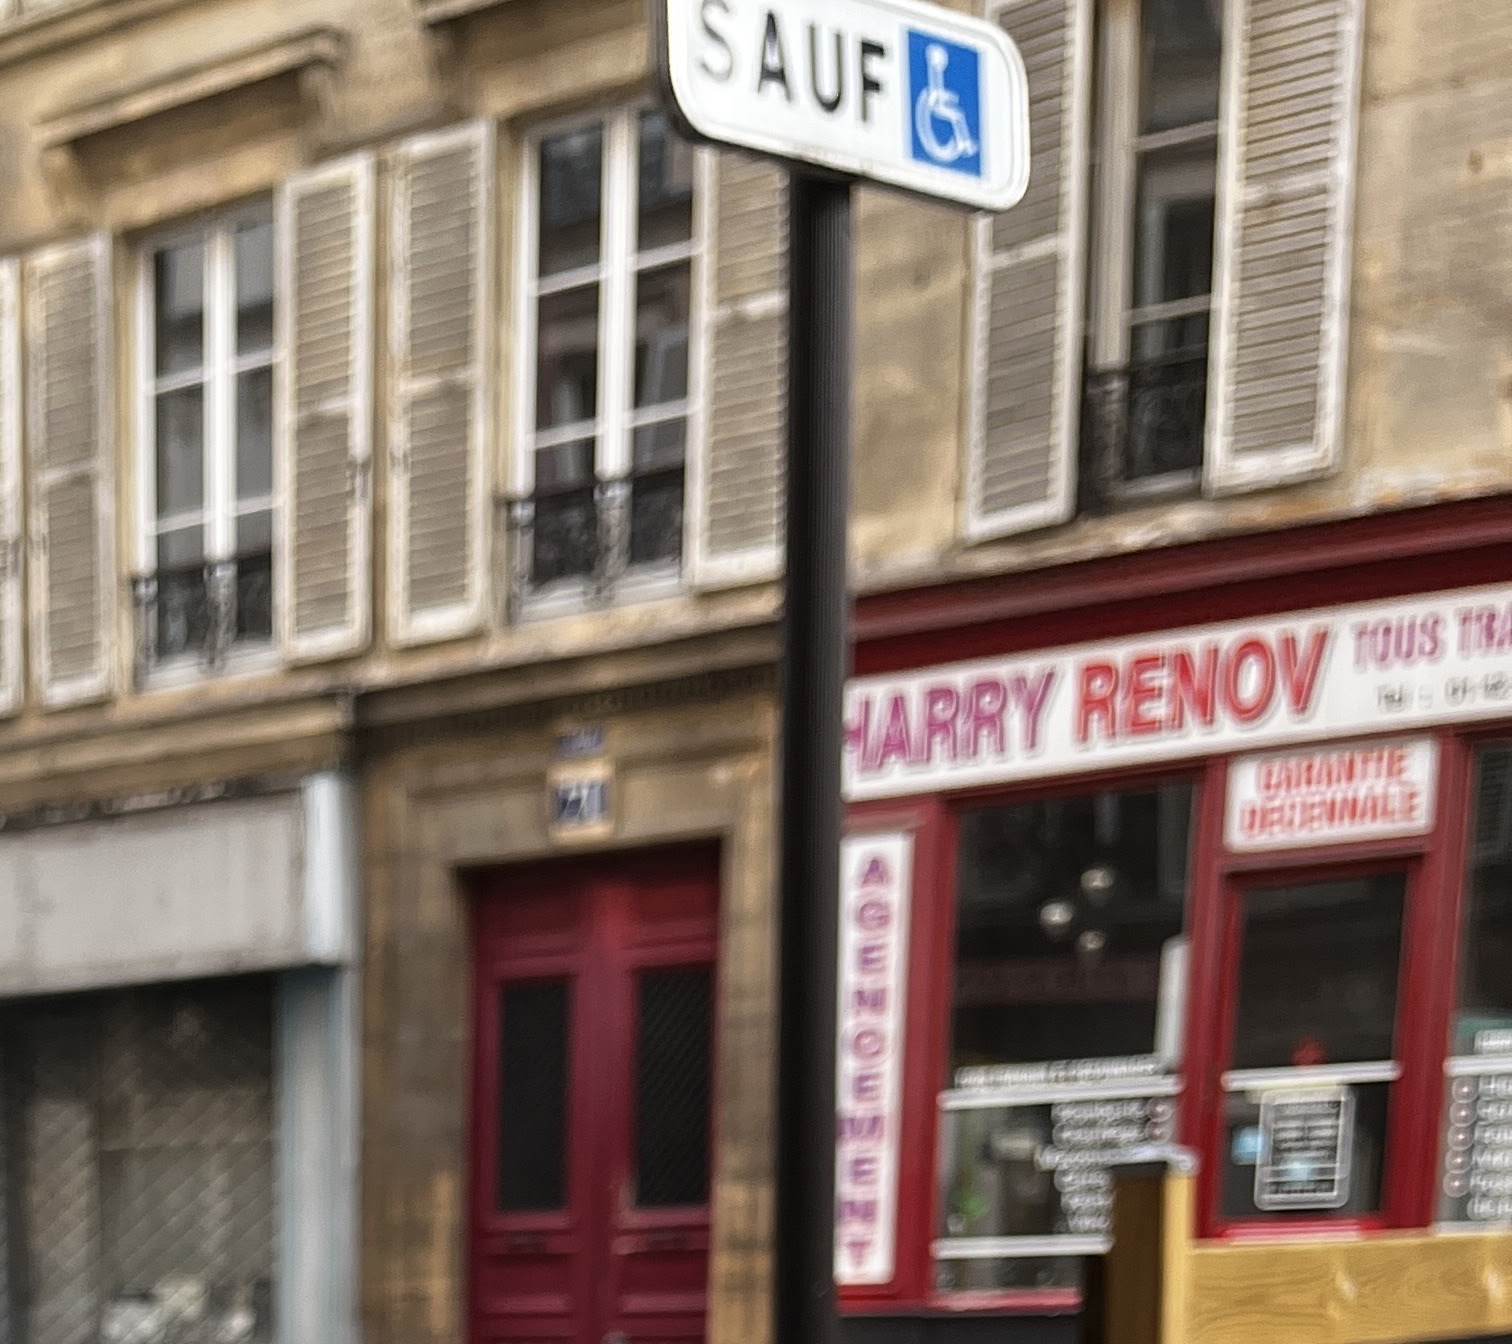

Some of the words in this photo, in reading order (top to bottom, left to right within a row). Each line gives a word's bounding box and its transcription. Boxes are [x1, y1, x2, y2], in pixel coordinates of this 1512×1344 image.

[700, 0, 886, 123] SAUF
[1350, 612, 1446, 673] TOUS
[844, 664, 1055, 772] HARRY
[1073, 629, 1330, 744] RENOV
[1256, 744, 1408, 796] GARANTIE
